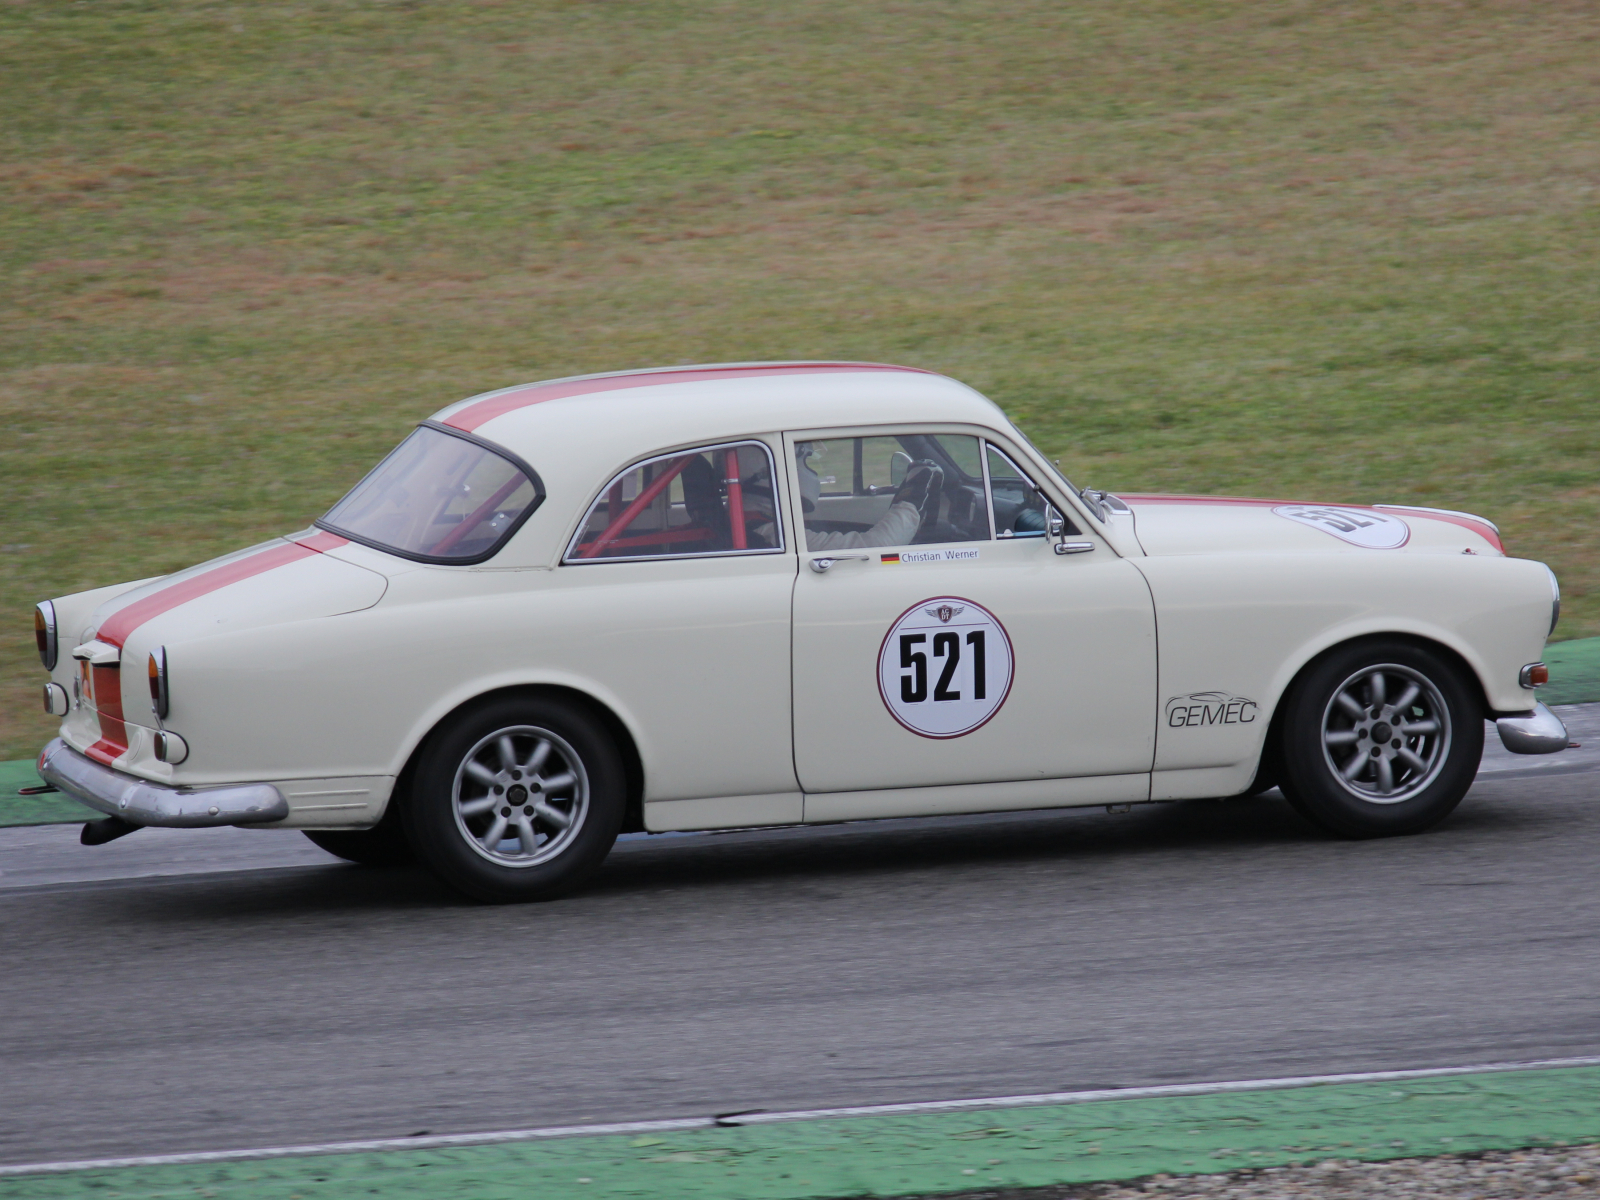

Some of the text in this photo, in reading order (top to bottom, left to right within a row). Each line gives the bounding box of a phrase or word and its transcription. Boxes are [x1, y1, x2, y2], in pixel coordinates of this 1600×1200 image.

[1290, 508, 1389, 532] 521
[901, 550, 978, 563] Christian Werner
[900, 630, 986, 704] 521
[1169, 702, 1257, 727] GEMEC
